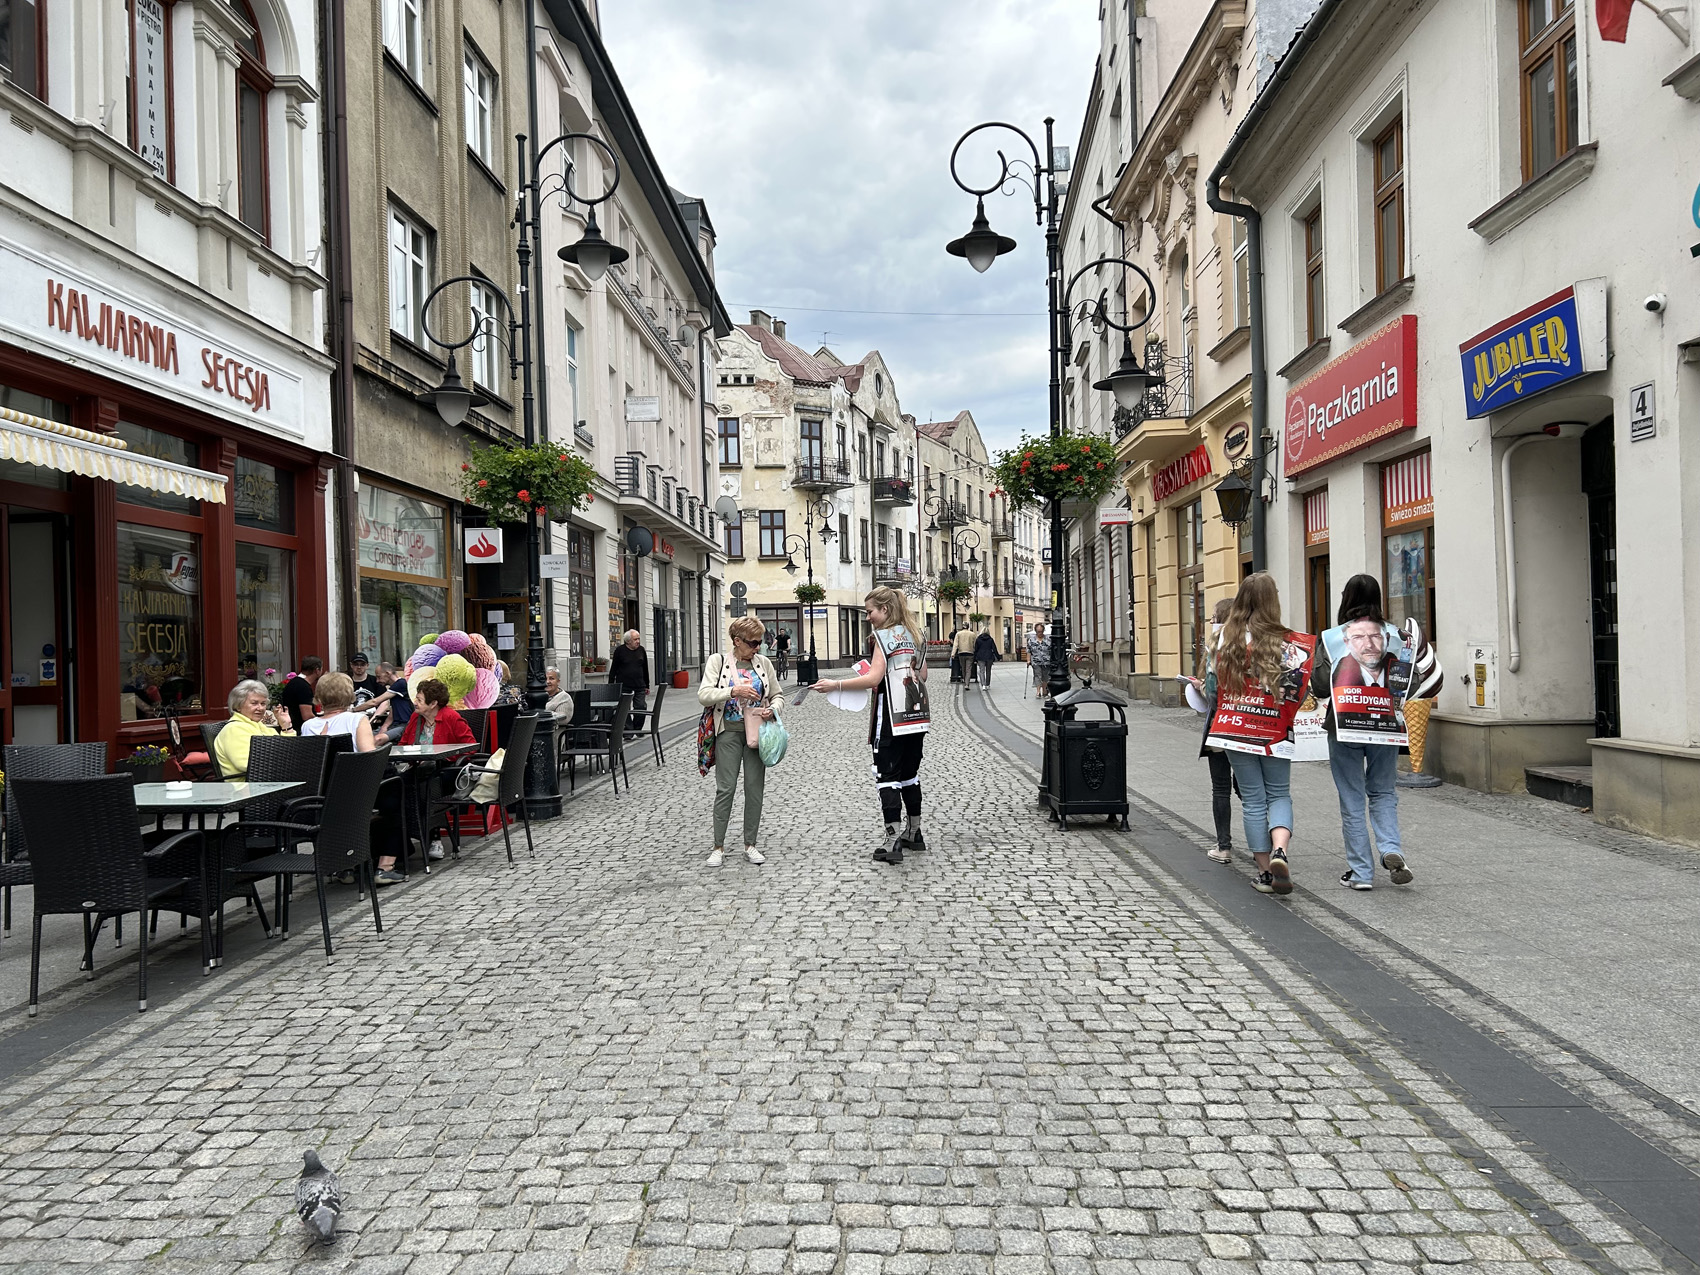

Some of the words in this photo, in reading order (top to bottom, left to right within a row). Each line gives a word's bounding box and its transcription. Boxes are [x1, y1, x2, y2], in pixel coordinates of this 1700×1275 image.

[141, 10, 162, 35] PIĘTRO
[152, 145, 164, 161] 784
[47, 278, 180, 375] KAWIARNIA
[202, 348, 271, 412] SECESJA
[1472, 316, 1571, 402] JUBILER
[1307, 361, 1398, 441] Pączkarnia
[1635, 391, 1648, 416] 4
[1153, 446, 1211, 502] ROSSMANN
[1390, 507, 1413, 523] świeżo
[372, 520, 425, 550] Santander
[124, 589, 187, 615] KAWIARNIA
[127, 622, 187, 659] SECESJA
[240, 627, 285, 657] SECESJA
[1337, 694, 1391, 707] BREJDYGANT
[1343, 687, 1363, 695] IGOR
[1217, 714, 1243, 726] 14-15
[1236, 705, 1280, 717] LITERATURY
